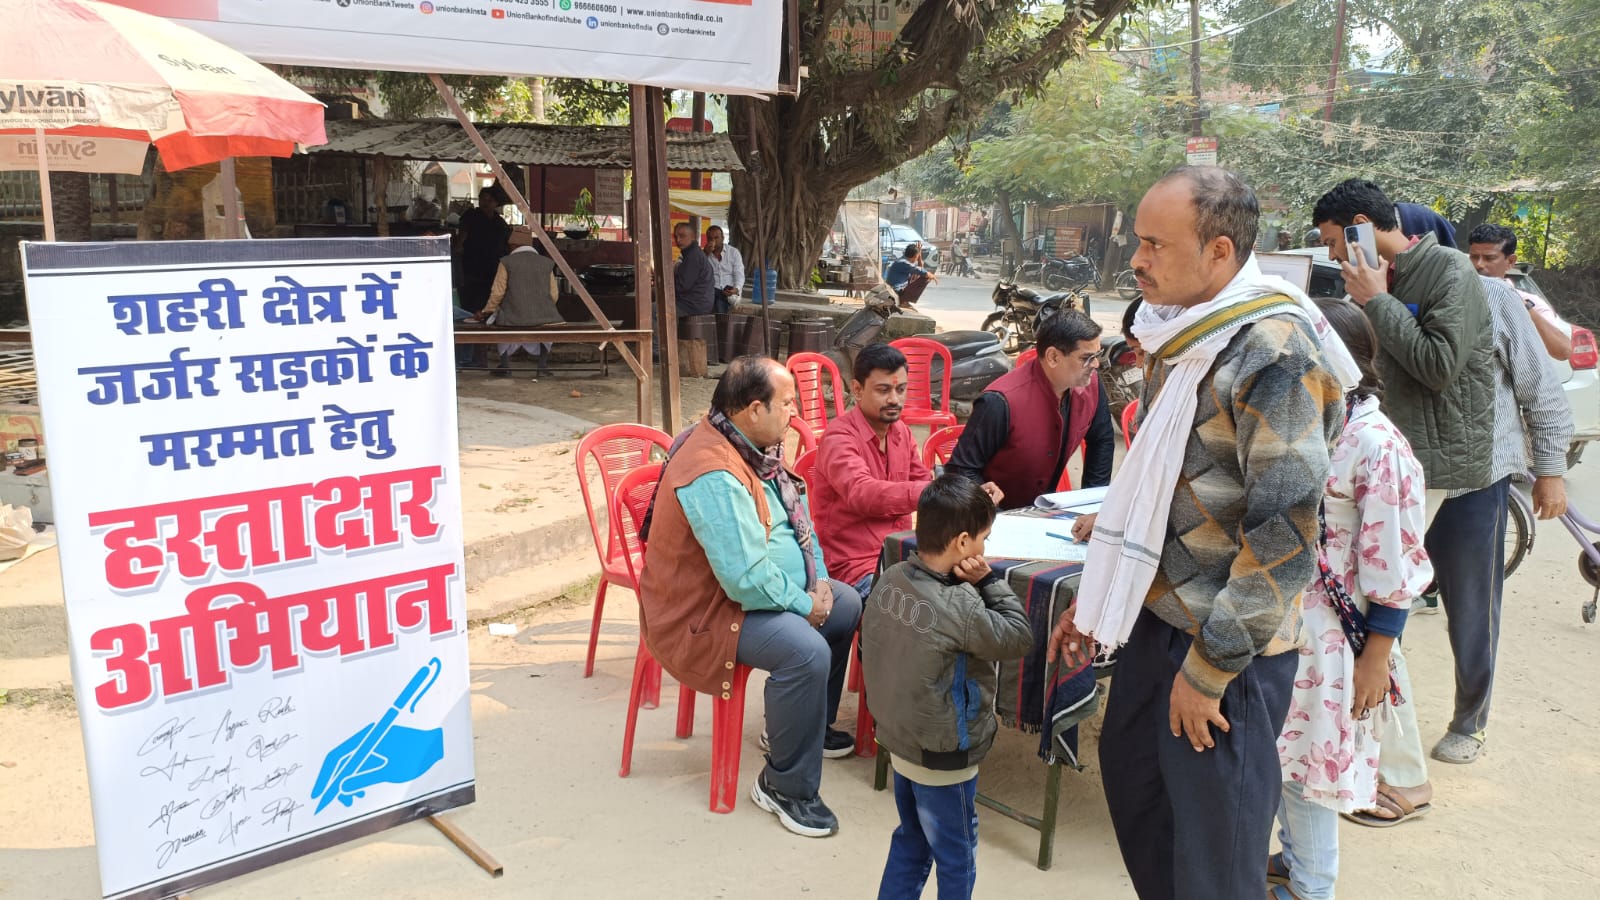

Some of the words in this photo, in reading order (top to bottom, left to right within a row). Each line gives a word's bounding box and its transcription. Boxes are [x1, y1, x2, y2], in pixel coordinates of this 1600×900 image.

[107, 278, 248, 334] शहरी
[263, 276, 348, 325] क्षेत्र
[355, 271, 402, 319] में
[79, 347, 221, 405] जर्जर
[230, 333, 377, 399] सड़कों
[383, 332, 433, 379] के
[140, 417, 315, 471] मरम्मत
[323, 405, 397, 460] हेतु
[88, 465, 442, 590] हस्ताक्षर
[90, 563, 457, 710] अभियान
